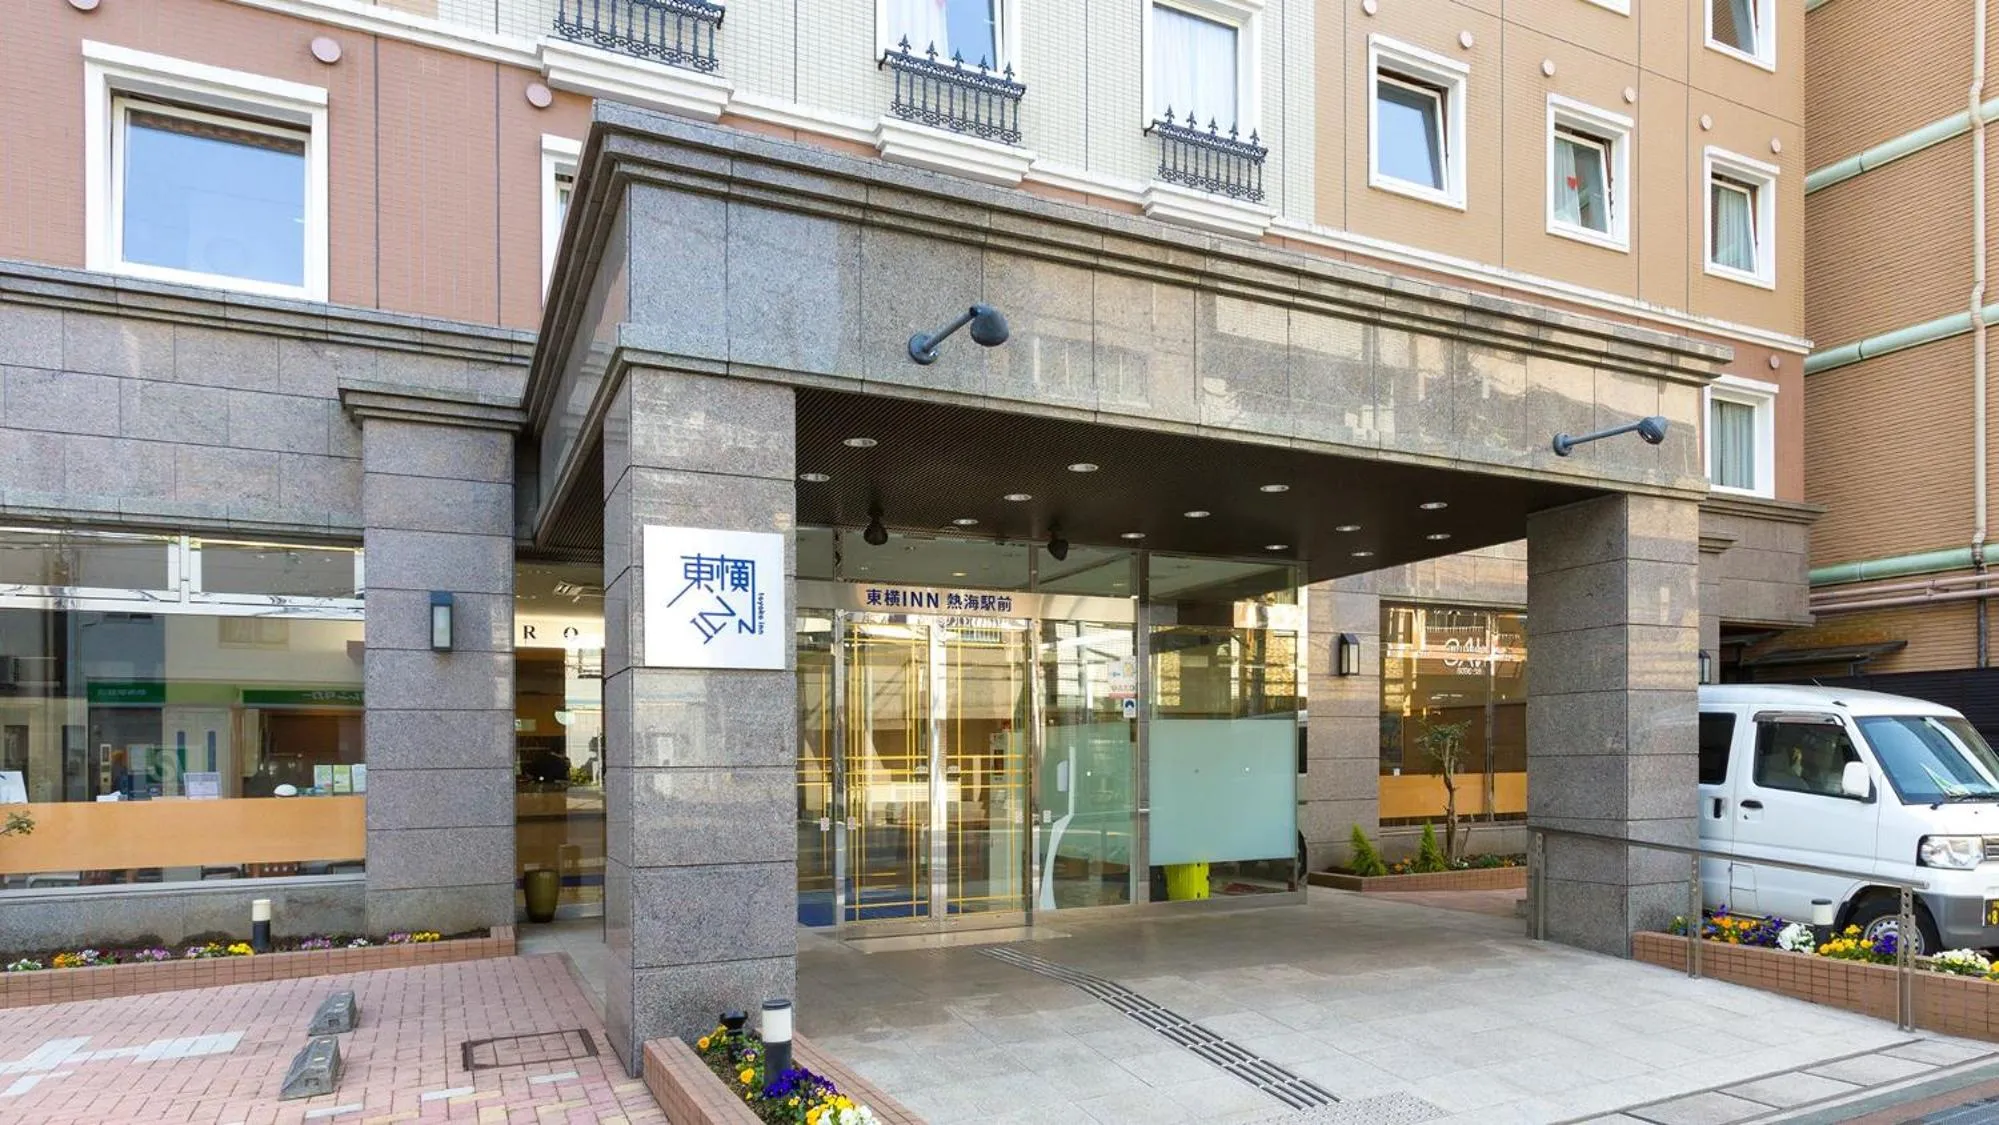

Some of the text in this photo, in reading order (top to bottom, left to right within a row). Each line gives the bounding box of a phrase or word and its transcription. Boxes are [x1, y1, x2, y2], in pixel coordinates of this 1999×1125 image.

[866, 589, 1013, 612] 東横INN 熱海駅前
